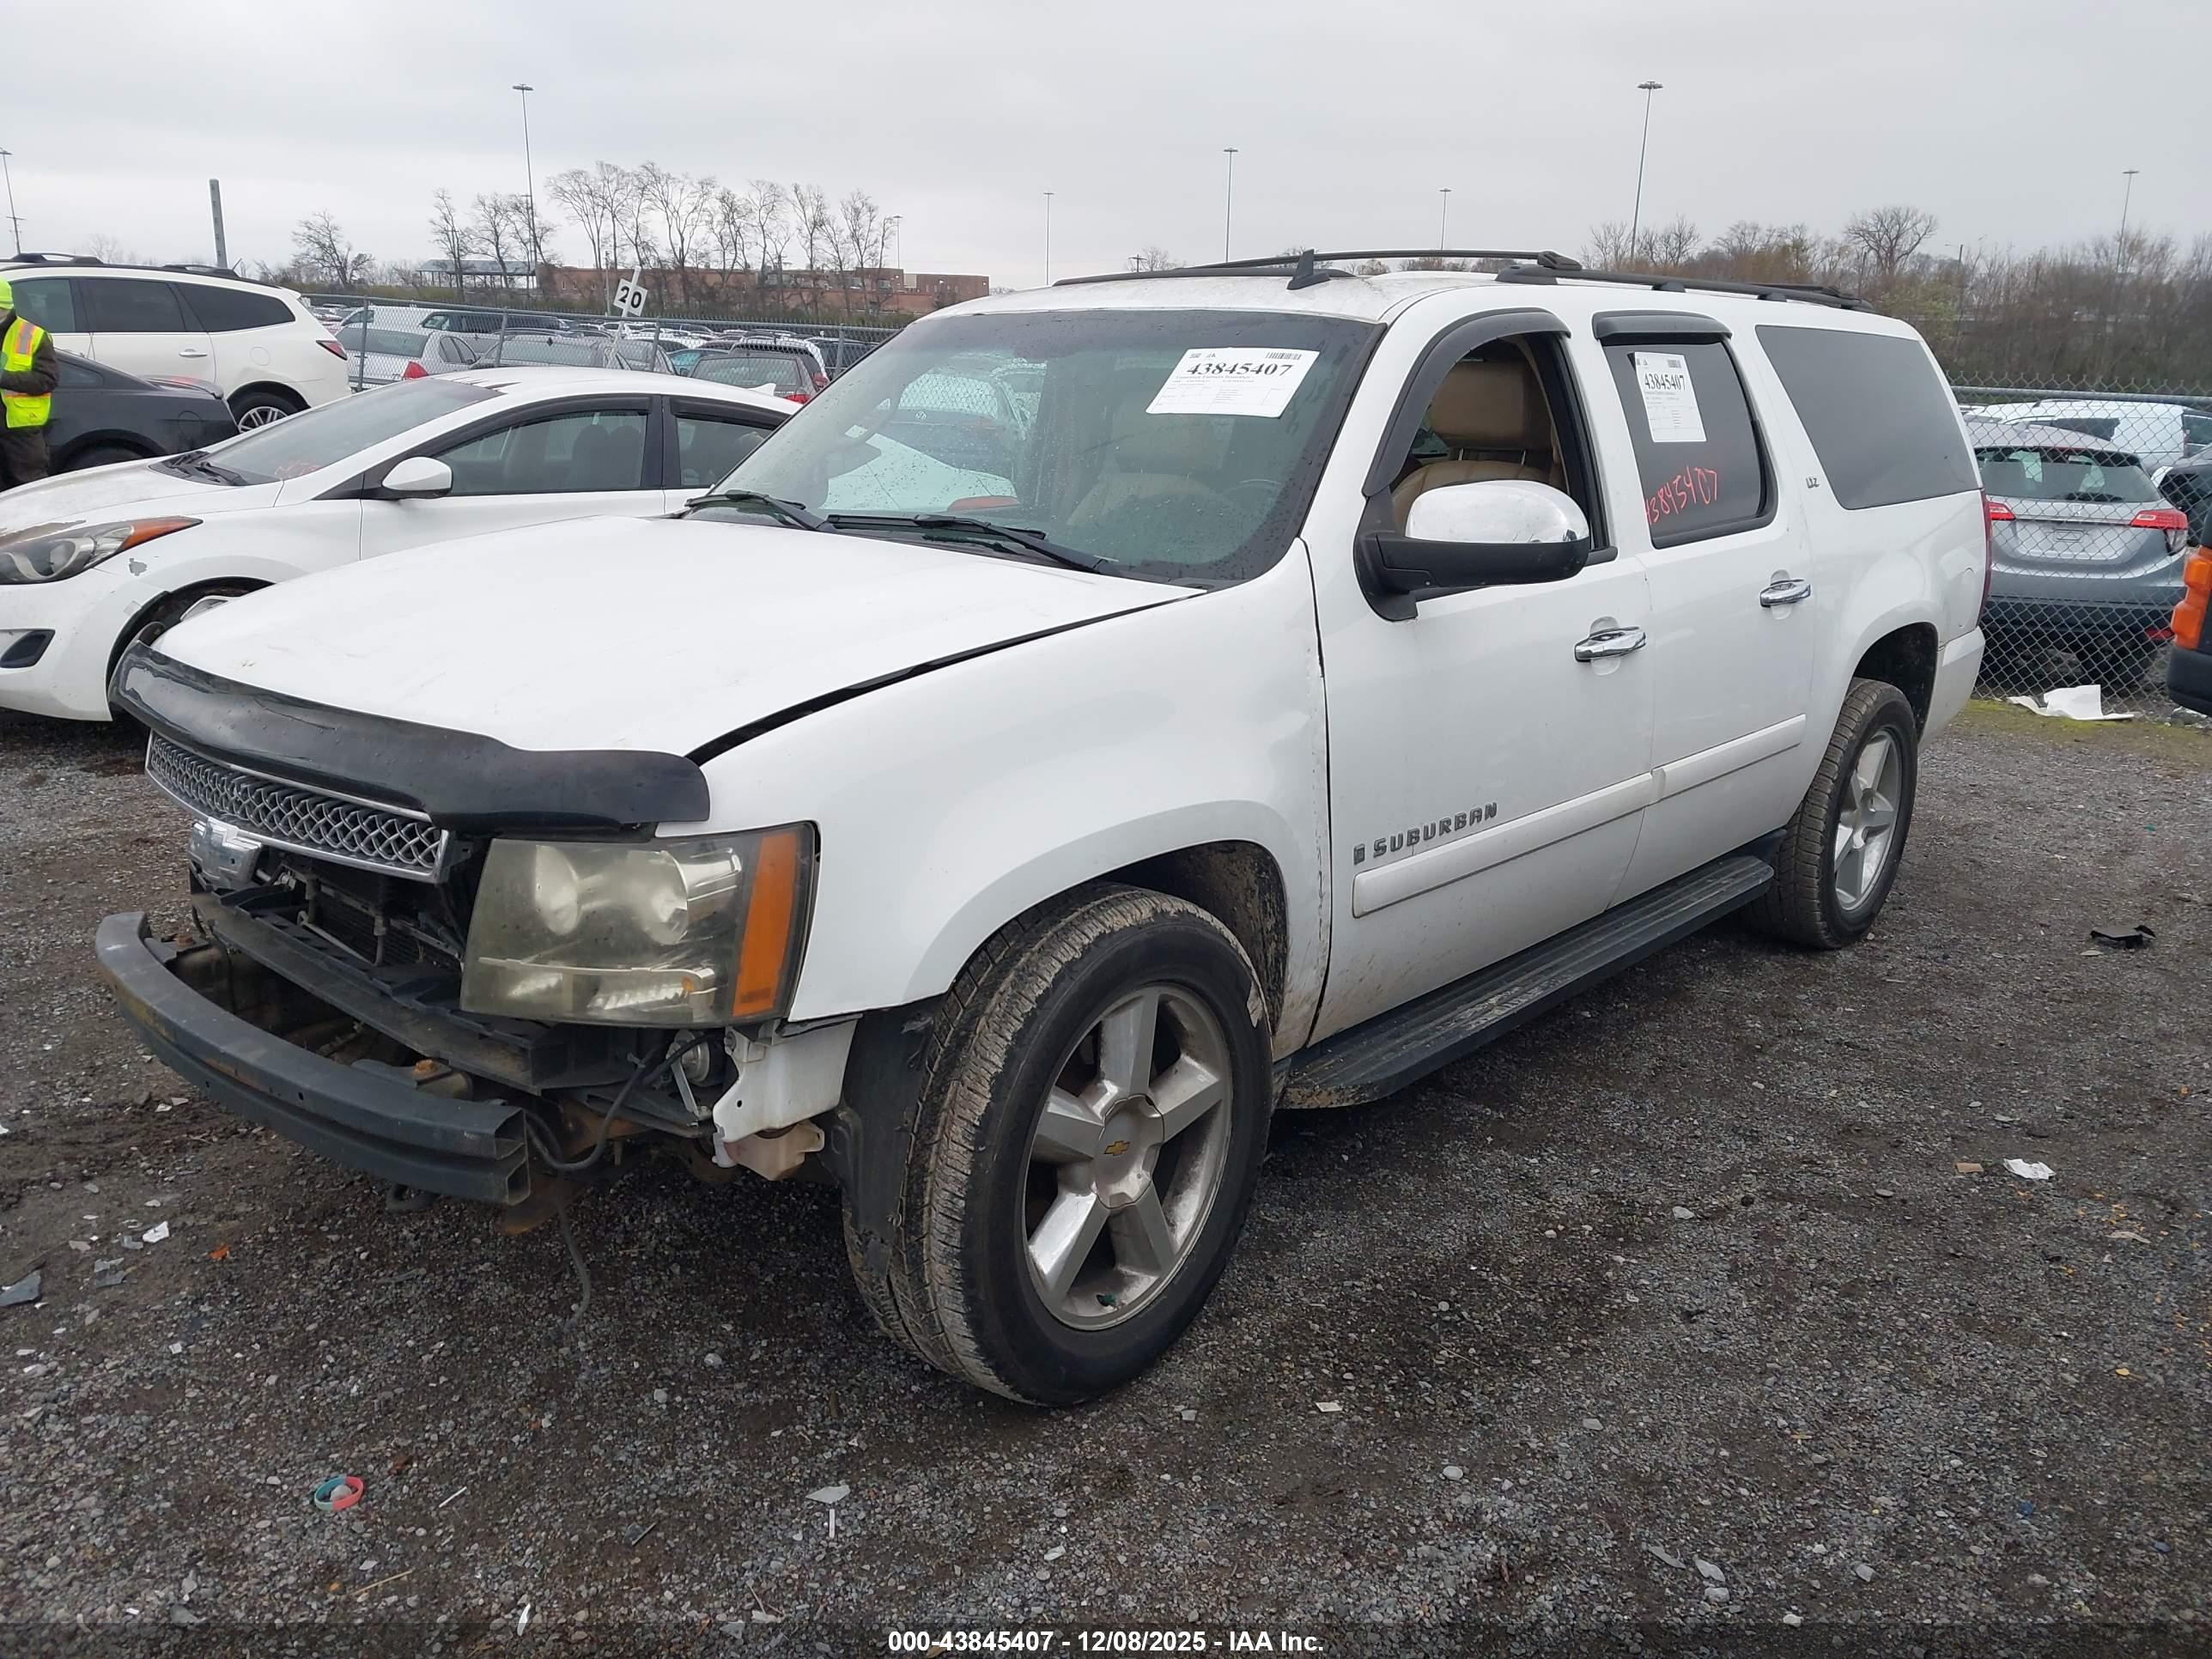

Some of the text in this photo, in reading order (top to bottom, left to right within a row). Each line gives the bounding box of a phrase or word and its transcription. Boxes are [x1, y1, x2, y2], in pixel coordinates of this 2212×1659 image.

[618, 285, 642, 308] 20
[1187, 362, 1294, 376] 43845407
[1644, 372, 1686, 392] 43845407
[1374, 802, 1498, 858] SUBURBAN
